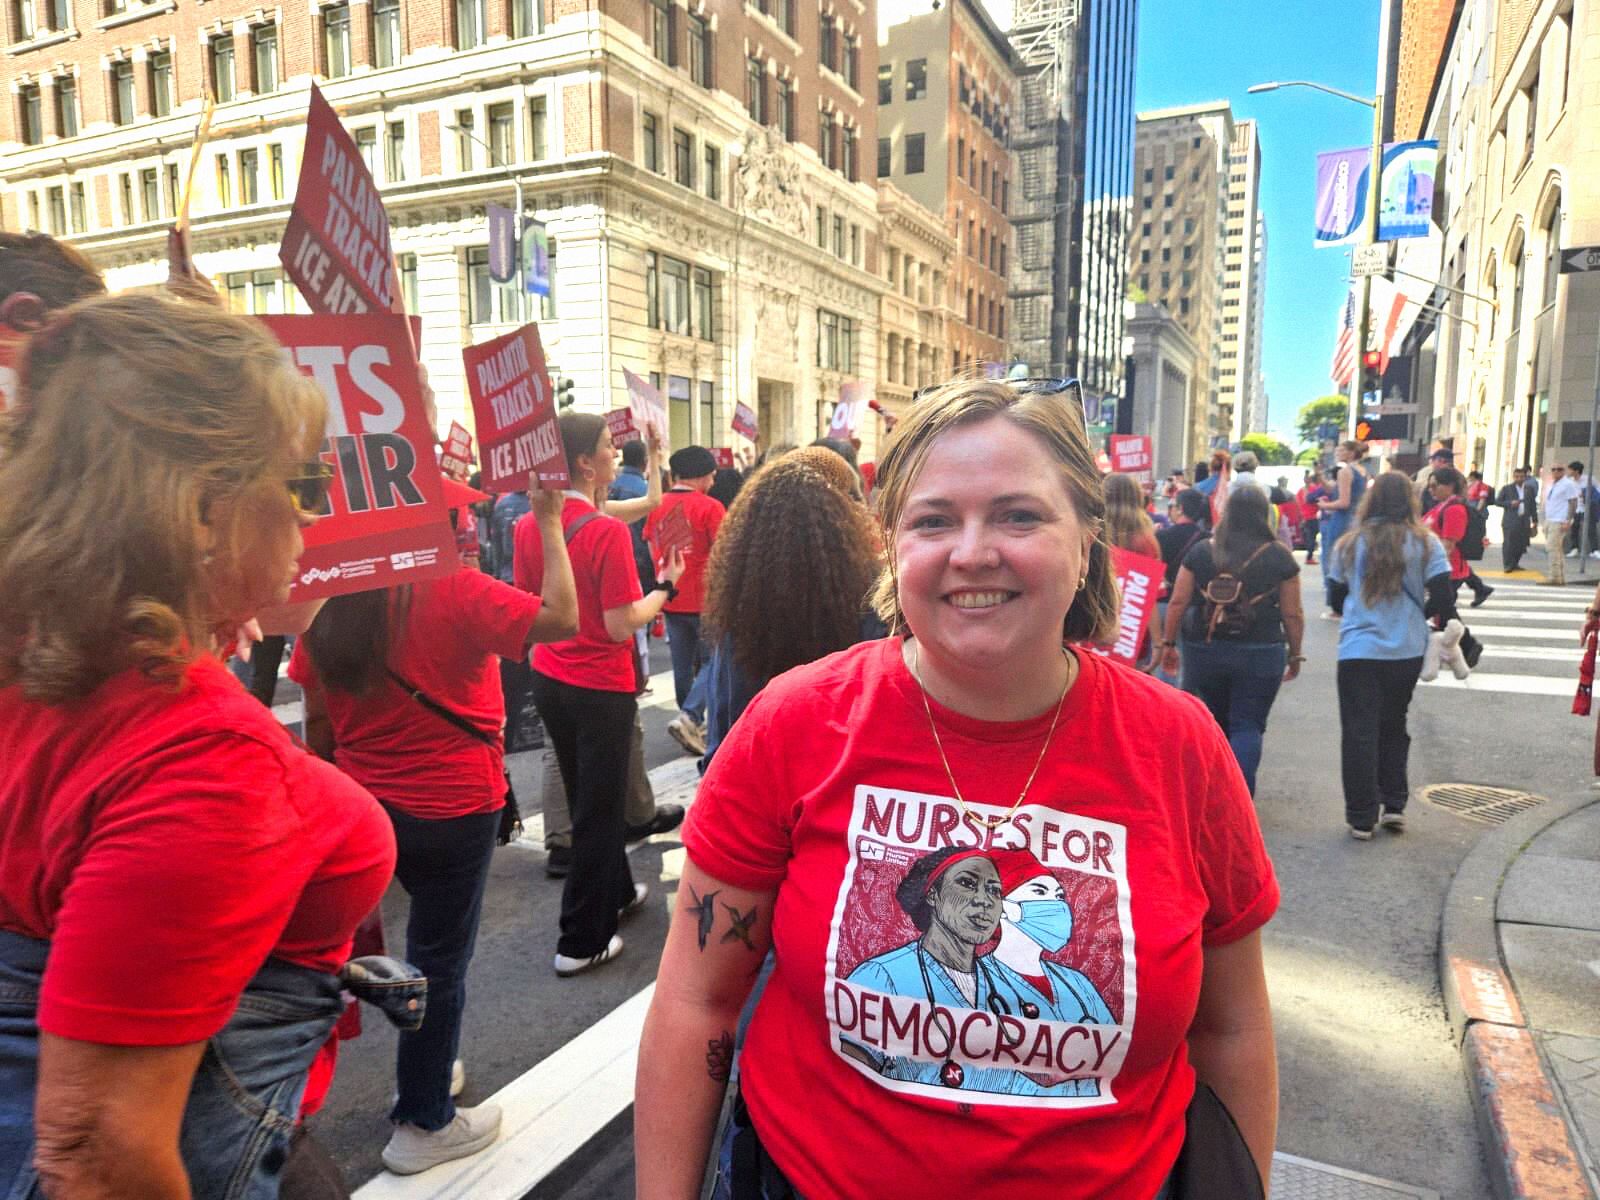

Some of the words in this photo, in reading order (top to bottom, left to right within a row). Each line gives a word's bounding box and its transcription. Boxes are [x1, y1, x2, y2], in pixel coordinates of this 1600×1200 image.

[294, 231, 331, 295] ICE
[281, 344, 405, 435] TS
[477, 335, 530, 398] PALANTIR
[491, 377, 534, 430] TRACKS
[490, 442, 513, 481] ICE
[515, 418, 560, 473] ATTACKS!
[1113, 570, 1150, 659] PALANTIR
[862, 794, 1032, 851] NURSES
[1041, 821, 1114, 874] FOR
[834, 982, 1122, 1074] DEMOCRACY
